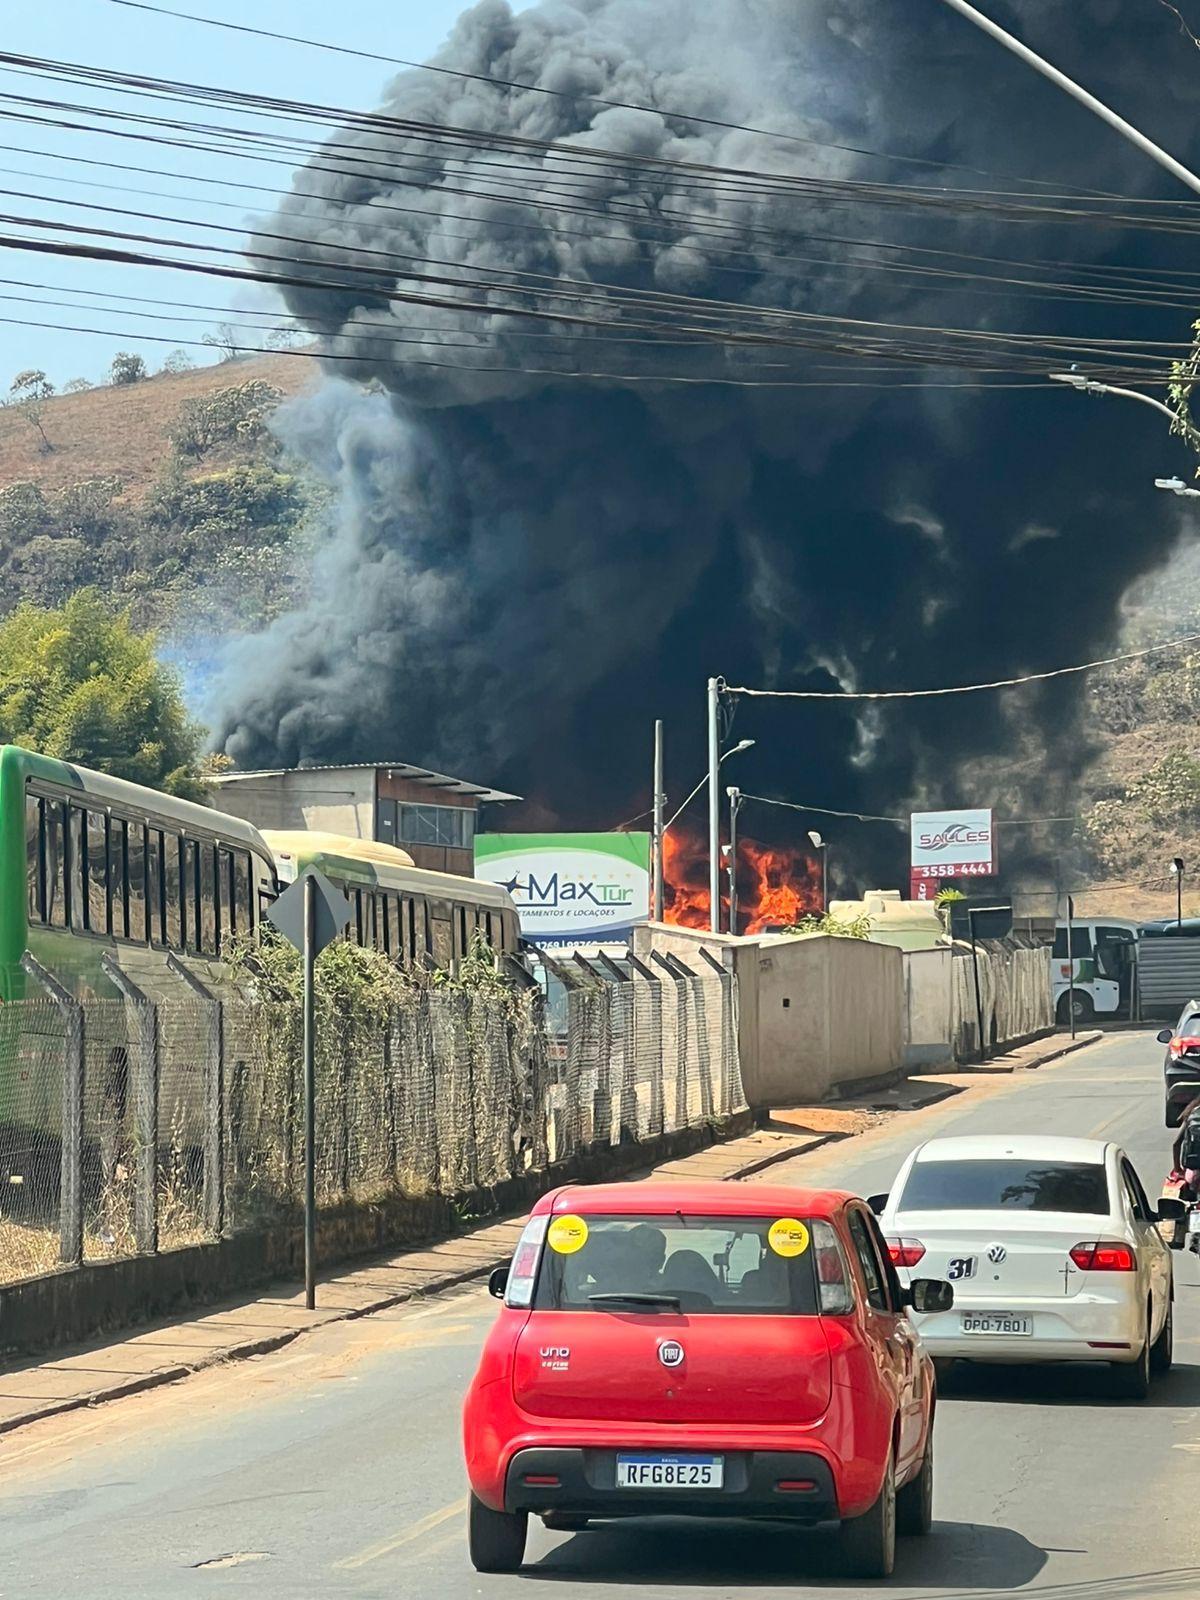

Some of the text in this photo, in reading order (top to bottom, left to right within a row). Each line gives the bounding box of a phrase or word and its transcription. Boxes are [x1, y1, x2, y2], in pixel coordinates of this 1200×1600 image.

[920, 831, 990, 845] SALLES
[921, 863, 992, 877] 3558-4441
[520, 908, 616, 918] TAMENTOS E LOCAÇÕES
[948, 1257, 974, 1280] 31
[627, 1465, 712, 1484] RFG8E25
